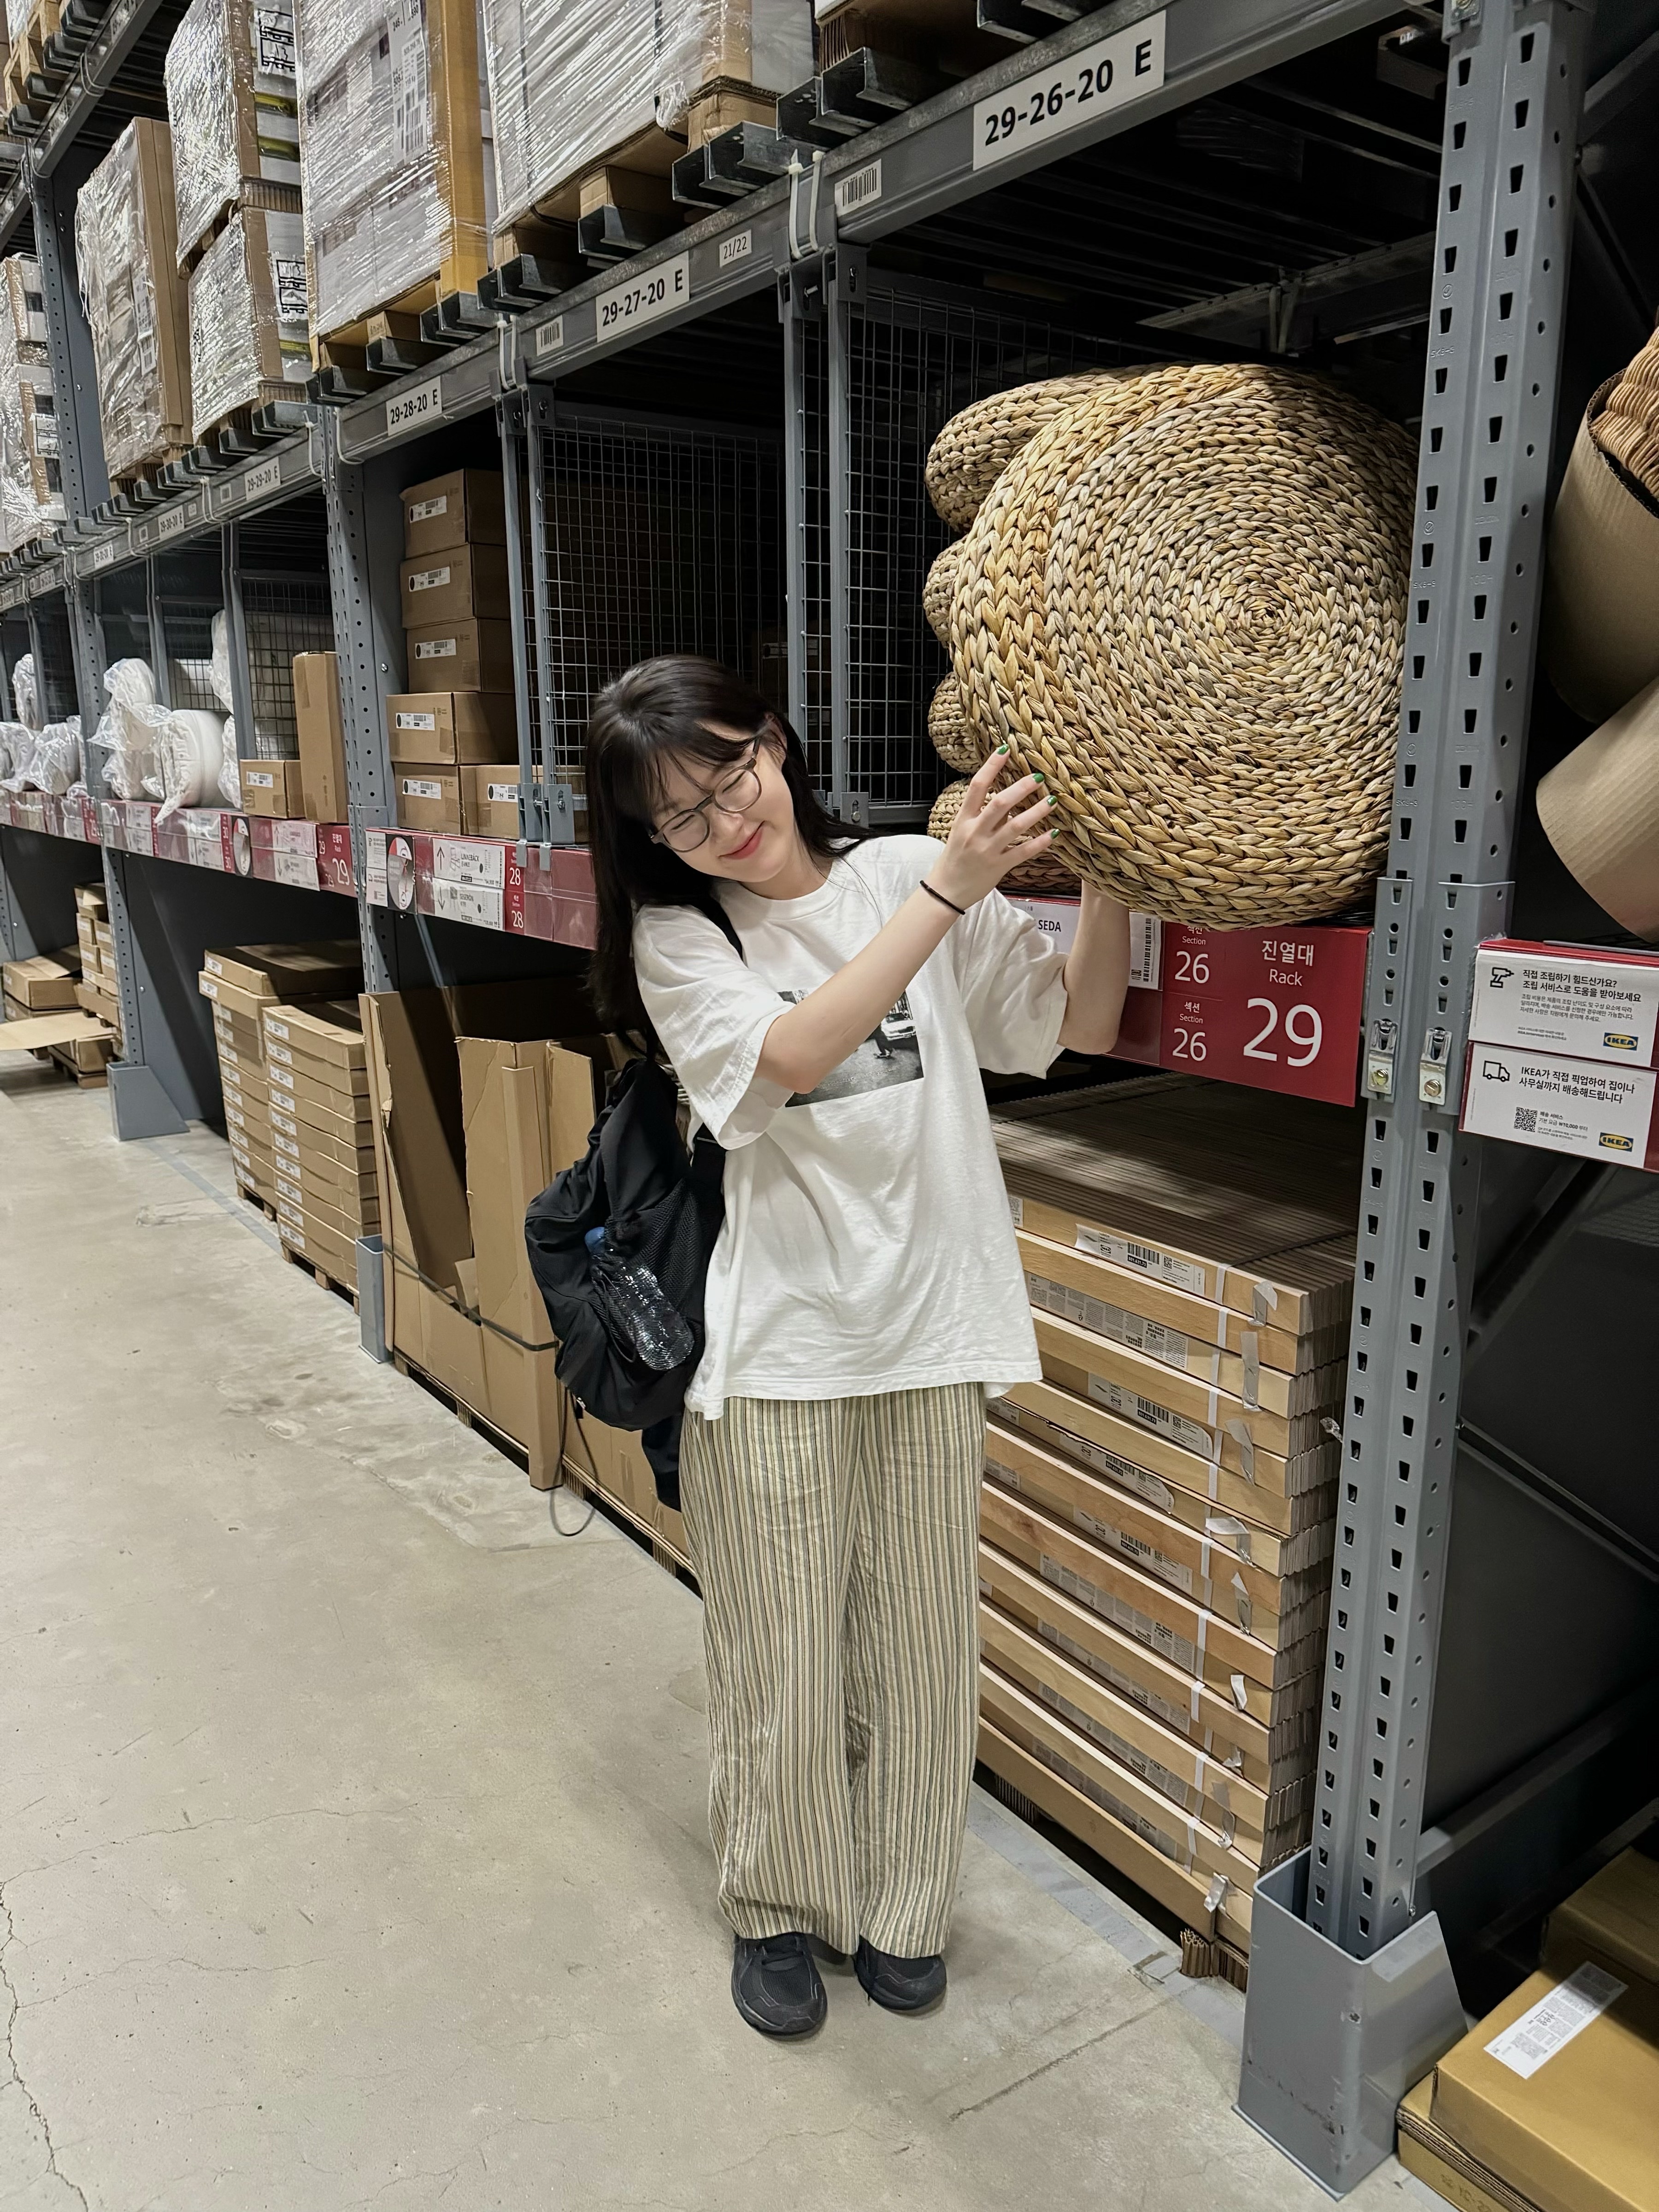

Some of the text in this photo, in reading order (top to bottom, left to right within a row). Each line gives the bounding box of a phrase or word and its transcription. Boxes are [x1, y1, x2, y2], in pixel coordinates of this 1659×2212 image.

[985, 39, 1152, 146] 29-26-20 E
[724, 236, 747, 259] 21/22
[602, 269, 682, 326] 29-27-20 E
[391, 388, 437, 424] 29-28-20 E
[247, 465, 278, 492] 29-29-20 E
[332, 858, 350, 885] 29
[510, 867, 521, 885] 28
[512, 910, 524, 929] 28
[1037, 919, 1061, 932] SEDA
[1182, 936, 1206, 945] Section
[1262, 940, 1314, 966] 진열대
[1175, 951, 1210, 983] 26
[1270, 969, 1303, 986] Rack
[1523, 969, 1617, 988] 직접 조립하기 힘드신가요?
[1523, 980, 1641, 1002] 조립 서비스로 도움을 받아보세요
[1180, 1013, 1203, 1024] Section
[1184, 1001, 1200, 1013] 섹션
[1243, 998, 1322, 1067] 29
[1606, 1035, 1636, 1047] IKEA
[1172, 1028, 1206, 1061] 26
[1519, 1077, 1623, 1104] 사무실까지 배송해드립니다
[1521, 1066, 1635, 1094] IKEA가 직접 픽업하여 집이나
[1601, 1135, 1631, 1148] IKEA
